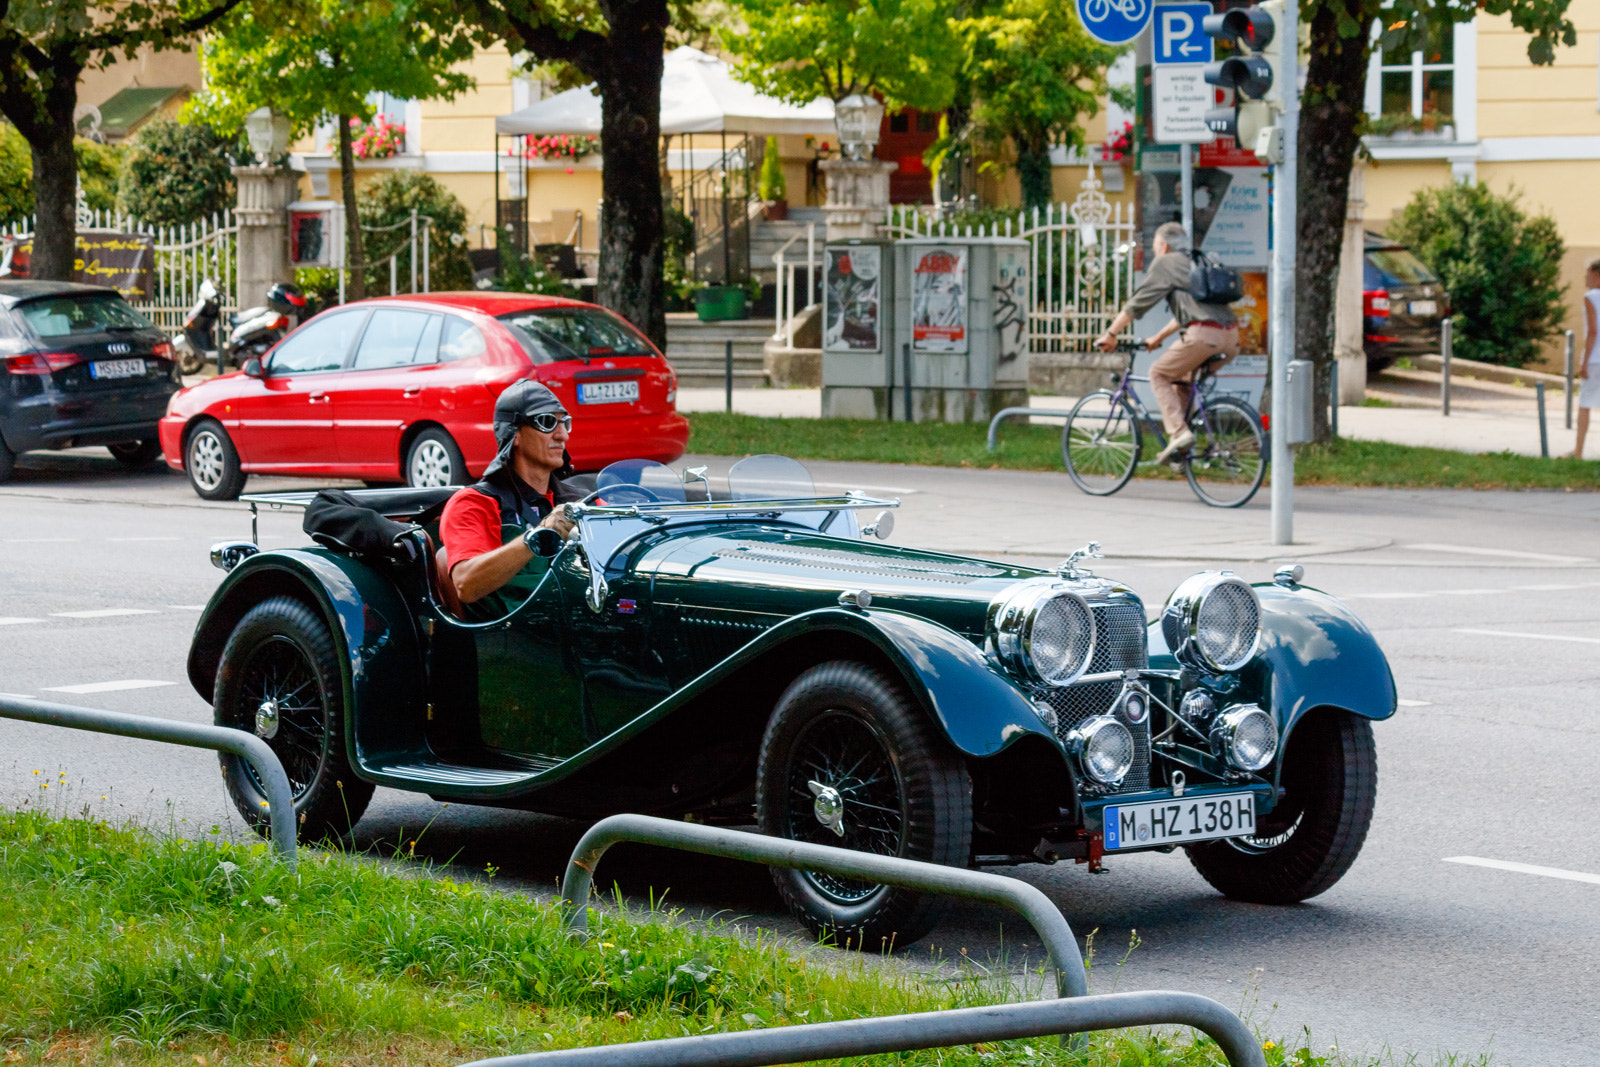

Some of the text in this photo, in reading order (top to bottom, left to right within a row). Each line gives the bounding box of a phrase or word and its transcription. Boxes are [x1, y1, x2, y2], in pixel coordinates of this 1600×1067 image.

[1162, 11, 1194, 57] P
[584, 386, 597, 399] LL
[619, 383, 637, 397] 249
[1109, 831, 1116, 842] D
[1120, 810, 1136, 842] M
[1150, 805, 1182, 839] HZ
